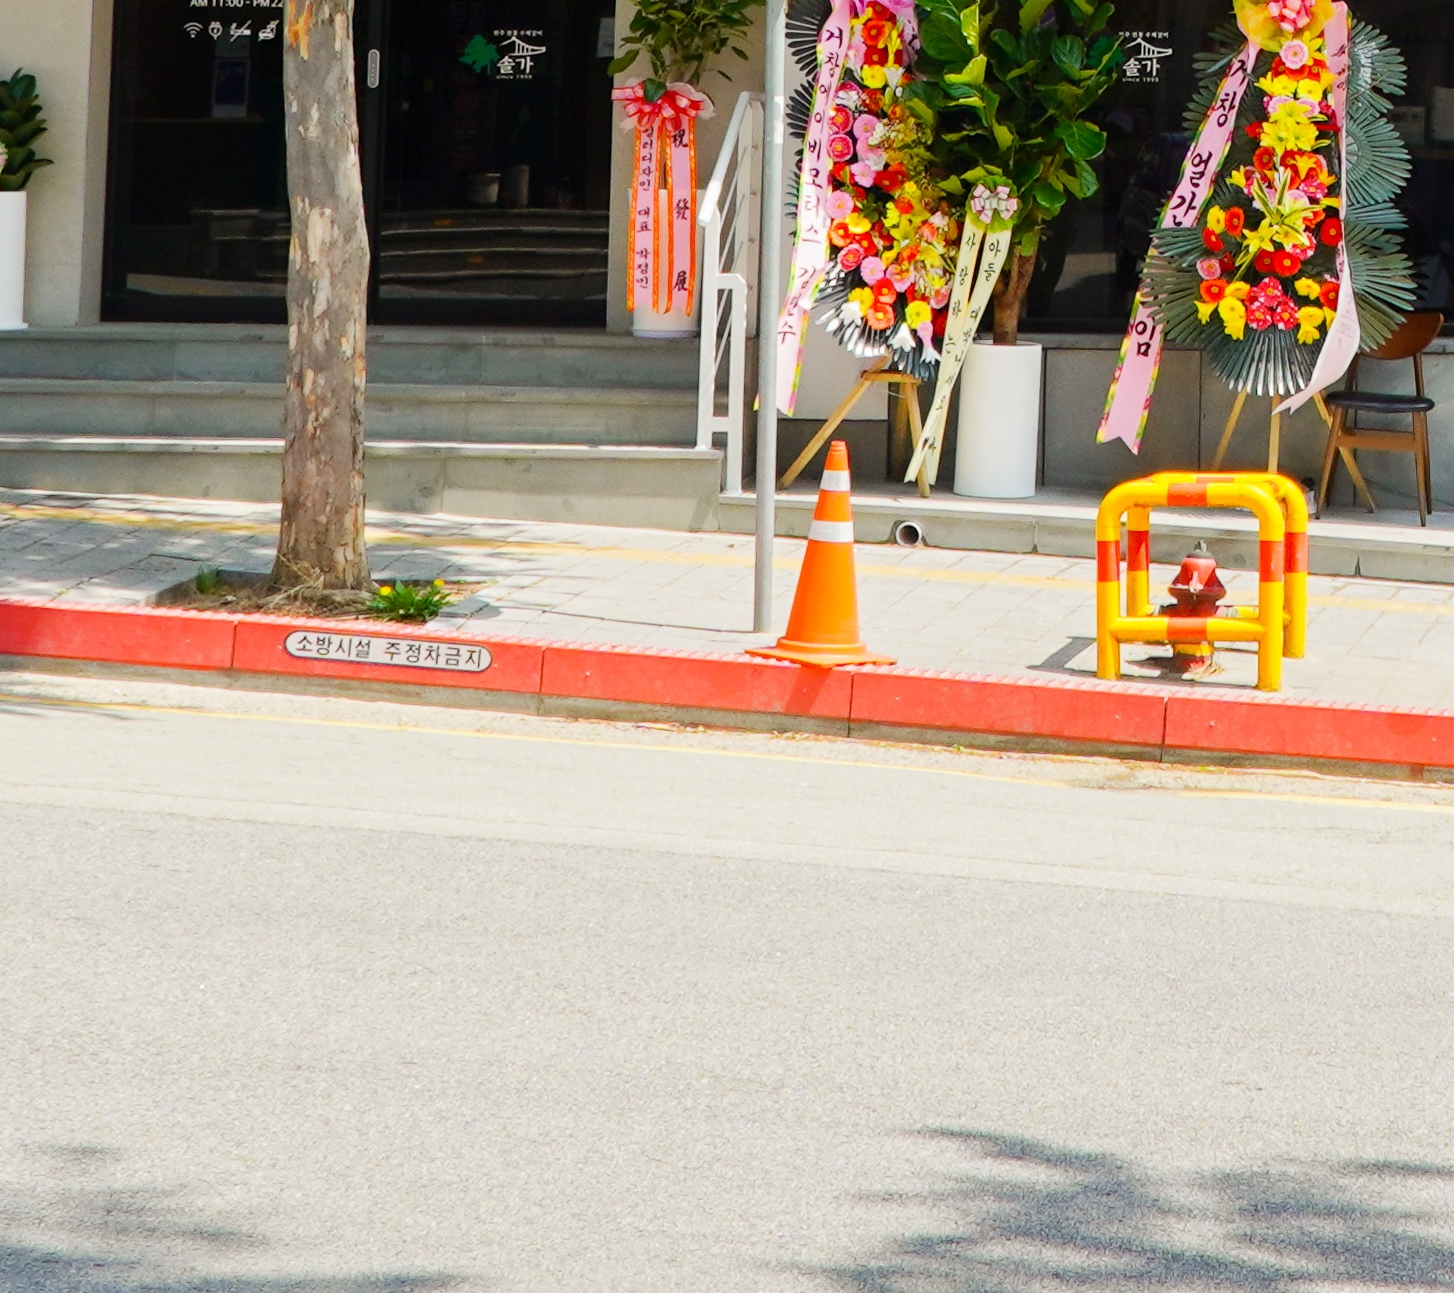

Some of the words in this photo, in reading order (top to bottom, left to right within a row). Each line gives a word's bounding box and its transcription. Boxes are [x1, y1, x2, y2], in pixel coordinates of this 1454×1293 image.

[496, 55, 534, 74] 솔가
[1123, 57, 1160, 76] 솔가
[295, 633, 371, 660] 소방시설
[384, 640, 483, 670] 주정차금지
